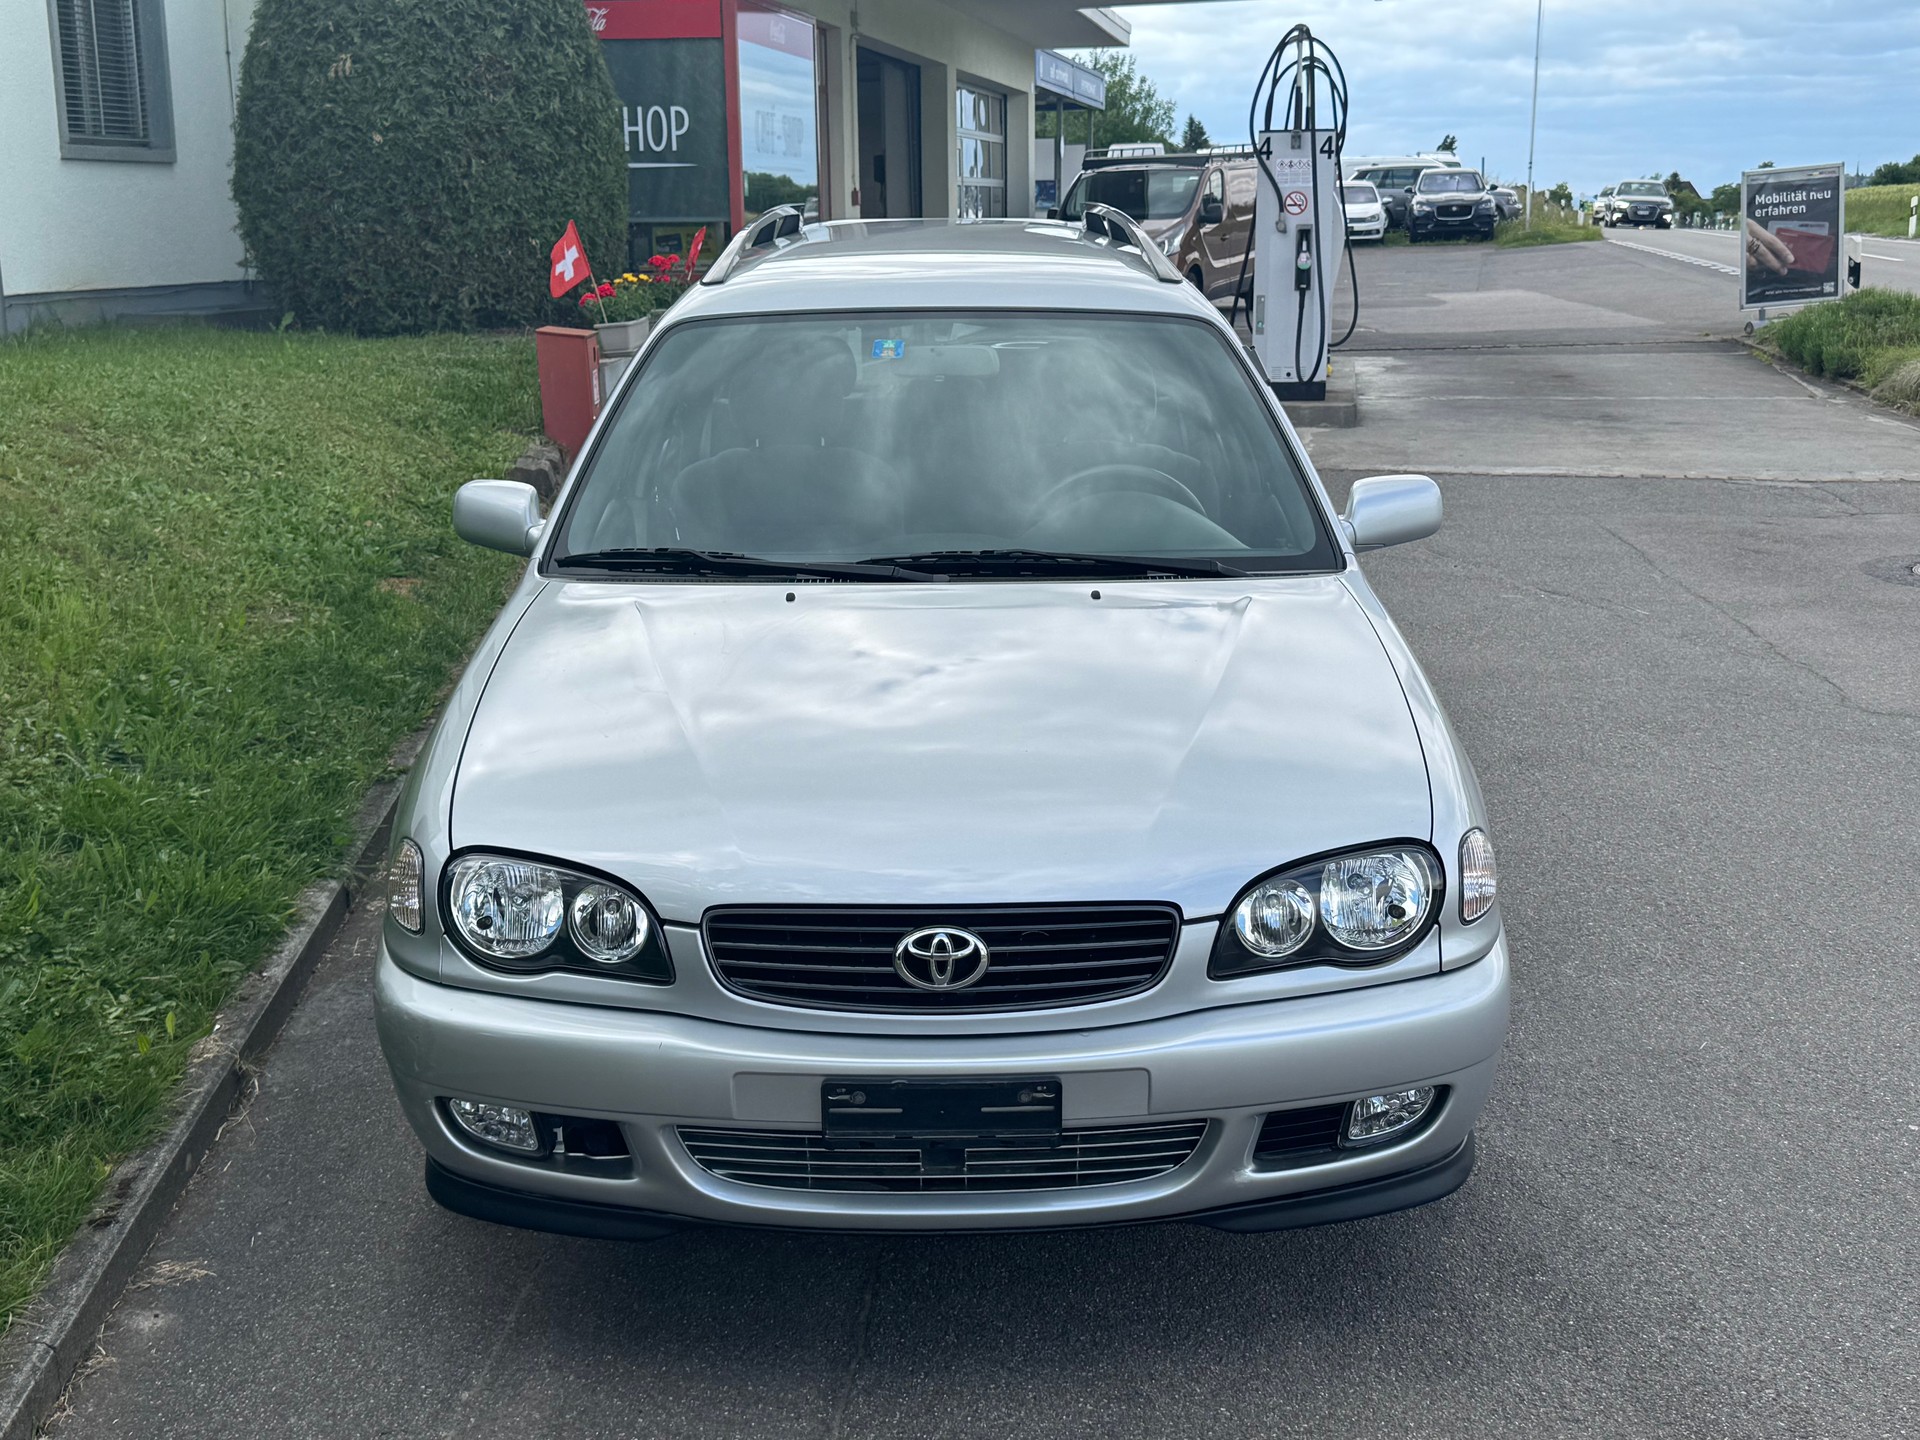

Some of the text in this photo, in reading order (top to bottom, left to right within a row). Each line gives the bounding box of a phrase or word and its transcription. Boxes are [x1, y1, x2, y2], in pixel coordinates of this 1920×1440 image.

[622, 105, 690, 152] HOP
[1259, 136, 1273, 160] 4
[1320, 136, 1335, 160] 4
[1755, 190, 1831, 205] Mobilität neu
[1755, 205, 1806, 217] erfahren
